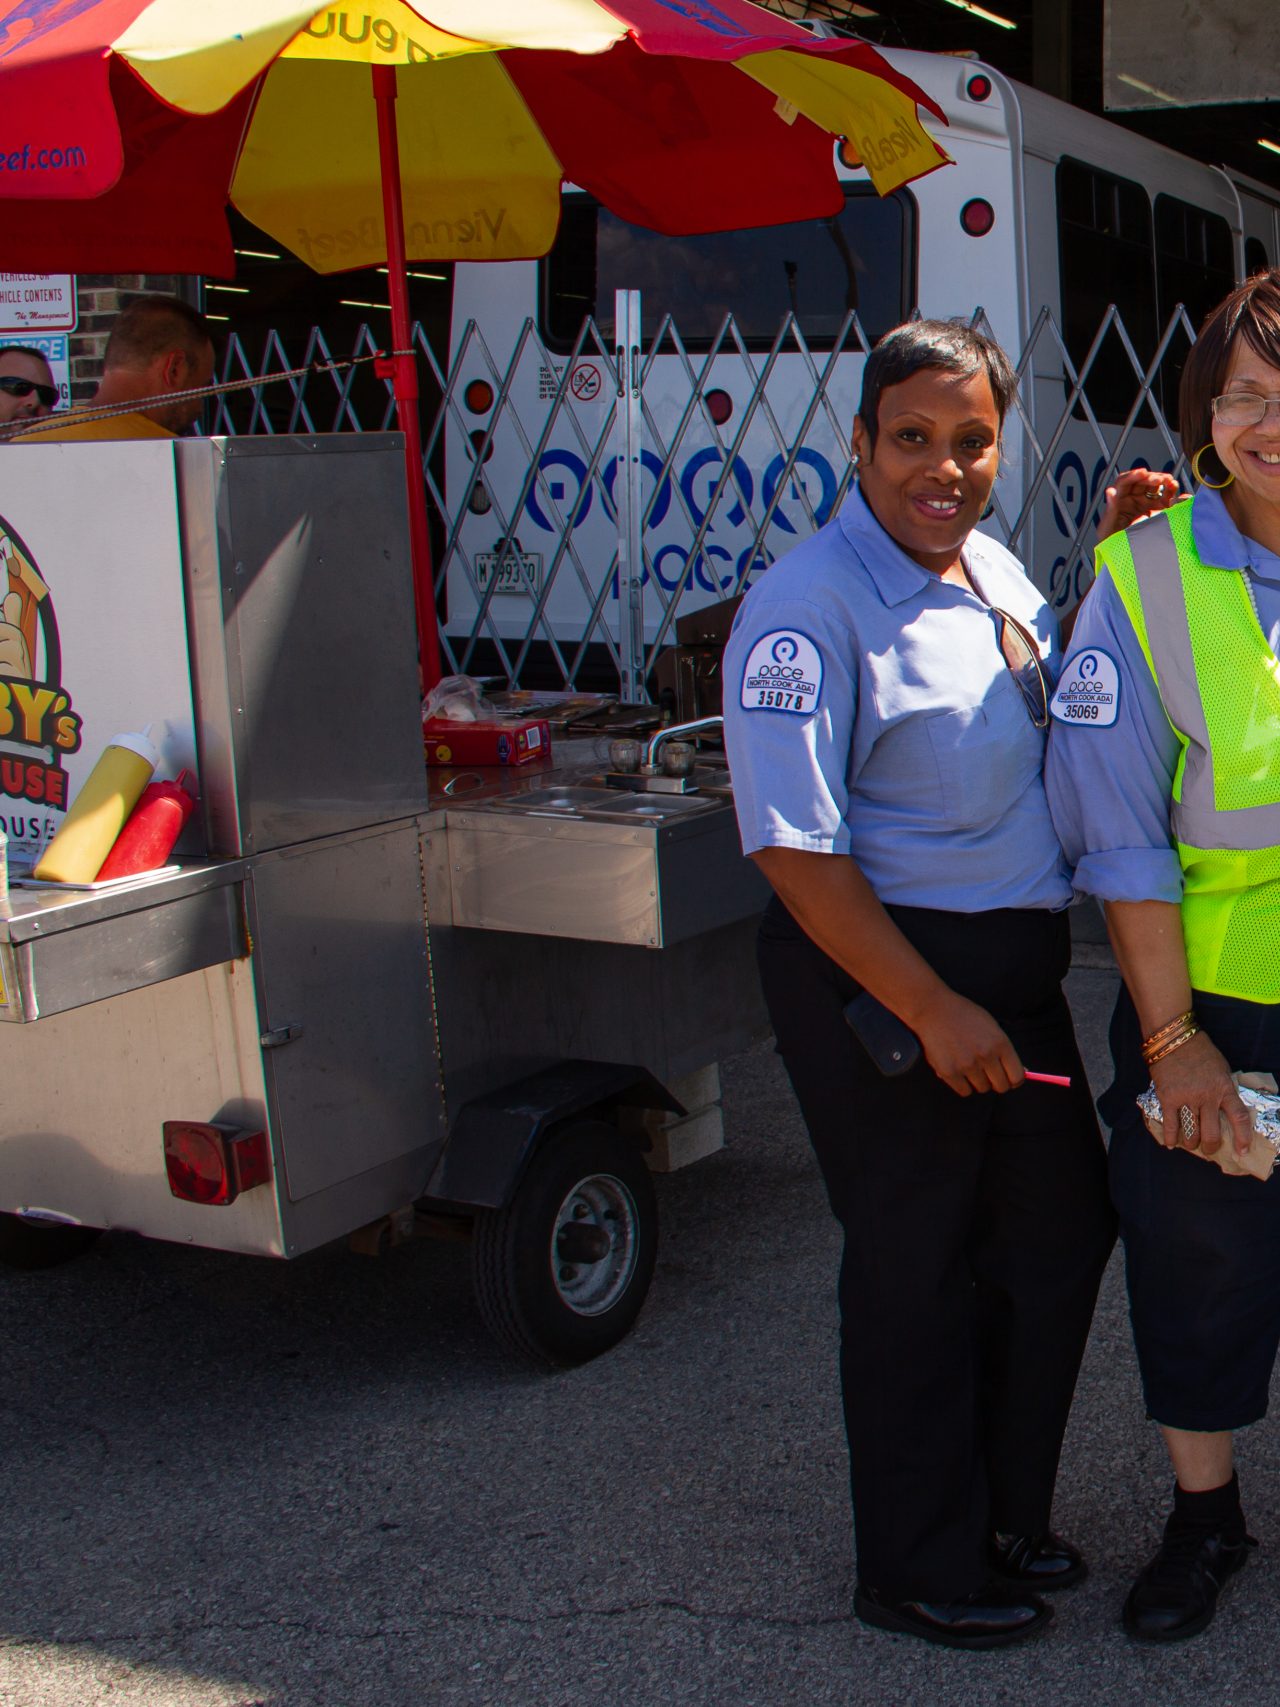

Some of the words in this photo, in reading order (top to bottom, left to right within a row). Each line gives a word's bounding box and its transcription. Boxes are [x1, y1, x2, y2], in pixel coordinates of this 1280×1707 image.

[24, 288, 62, 302] CONTENTS
[15, 311, 27, 320] The
[29, 311, 70, 321] Management
[759, 665, 804, 680] pace
[771, 680, 794, 688] COOK
[795, 683, 812, 692] ADA
[1069, 681, 1104, 693] pace
[758, 690, 804, 710] 35078
[1064, 704, 1099, 719] 35069
